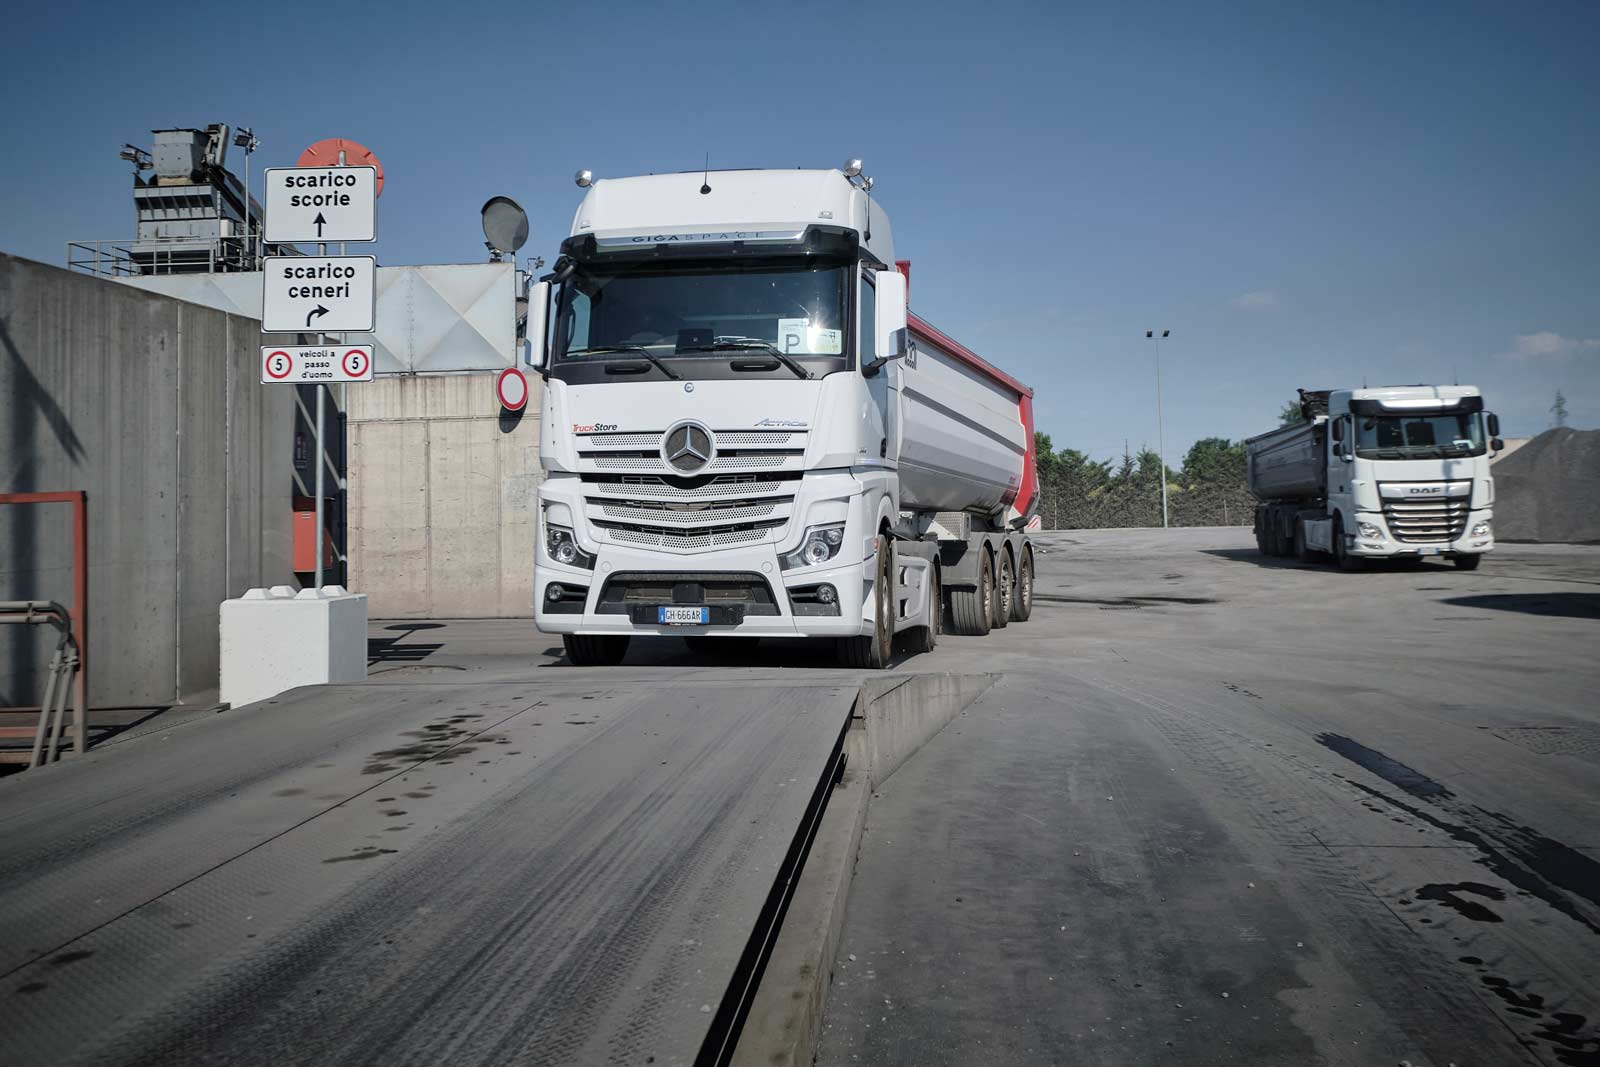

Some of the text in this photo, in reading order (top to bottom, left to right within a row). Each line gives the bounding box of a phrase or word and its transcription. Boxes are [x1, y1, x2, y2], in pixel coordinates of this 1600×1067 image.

[285, 171, 356, 188] scarico
[290, 190, 351, 207] scorie
[632, 231, 764, 243] GIGASPACE
[283, 263, 355, 279] scarico
[288, 282, 350, 298] ceneri
[299, 350, 328, 358] veicoli
[275, 358, 283, 372] 5
[304, 361, 330, 369] passo
[351, 356, 359, 370] 5
[301, 371, 333, 379] d'uomo
[572, 423, 618, 432] TruckStore
